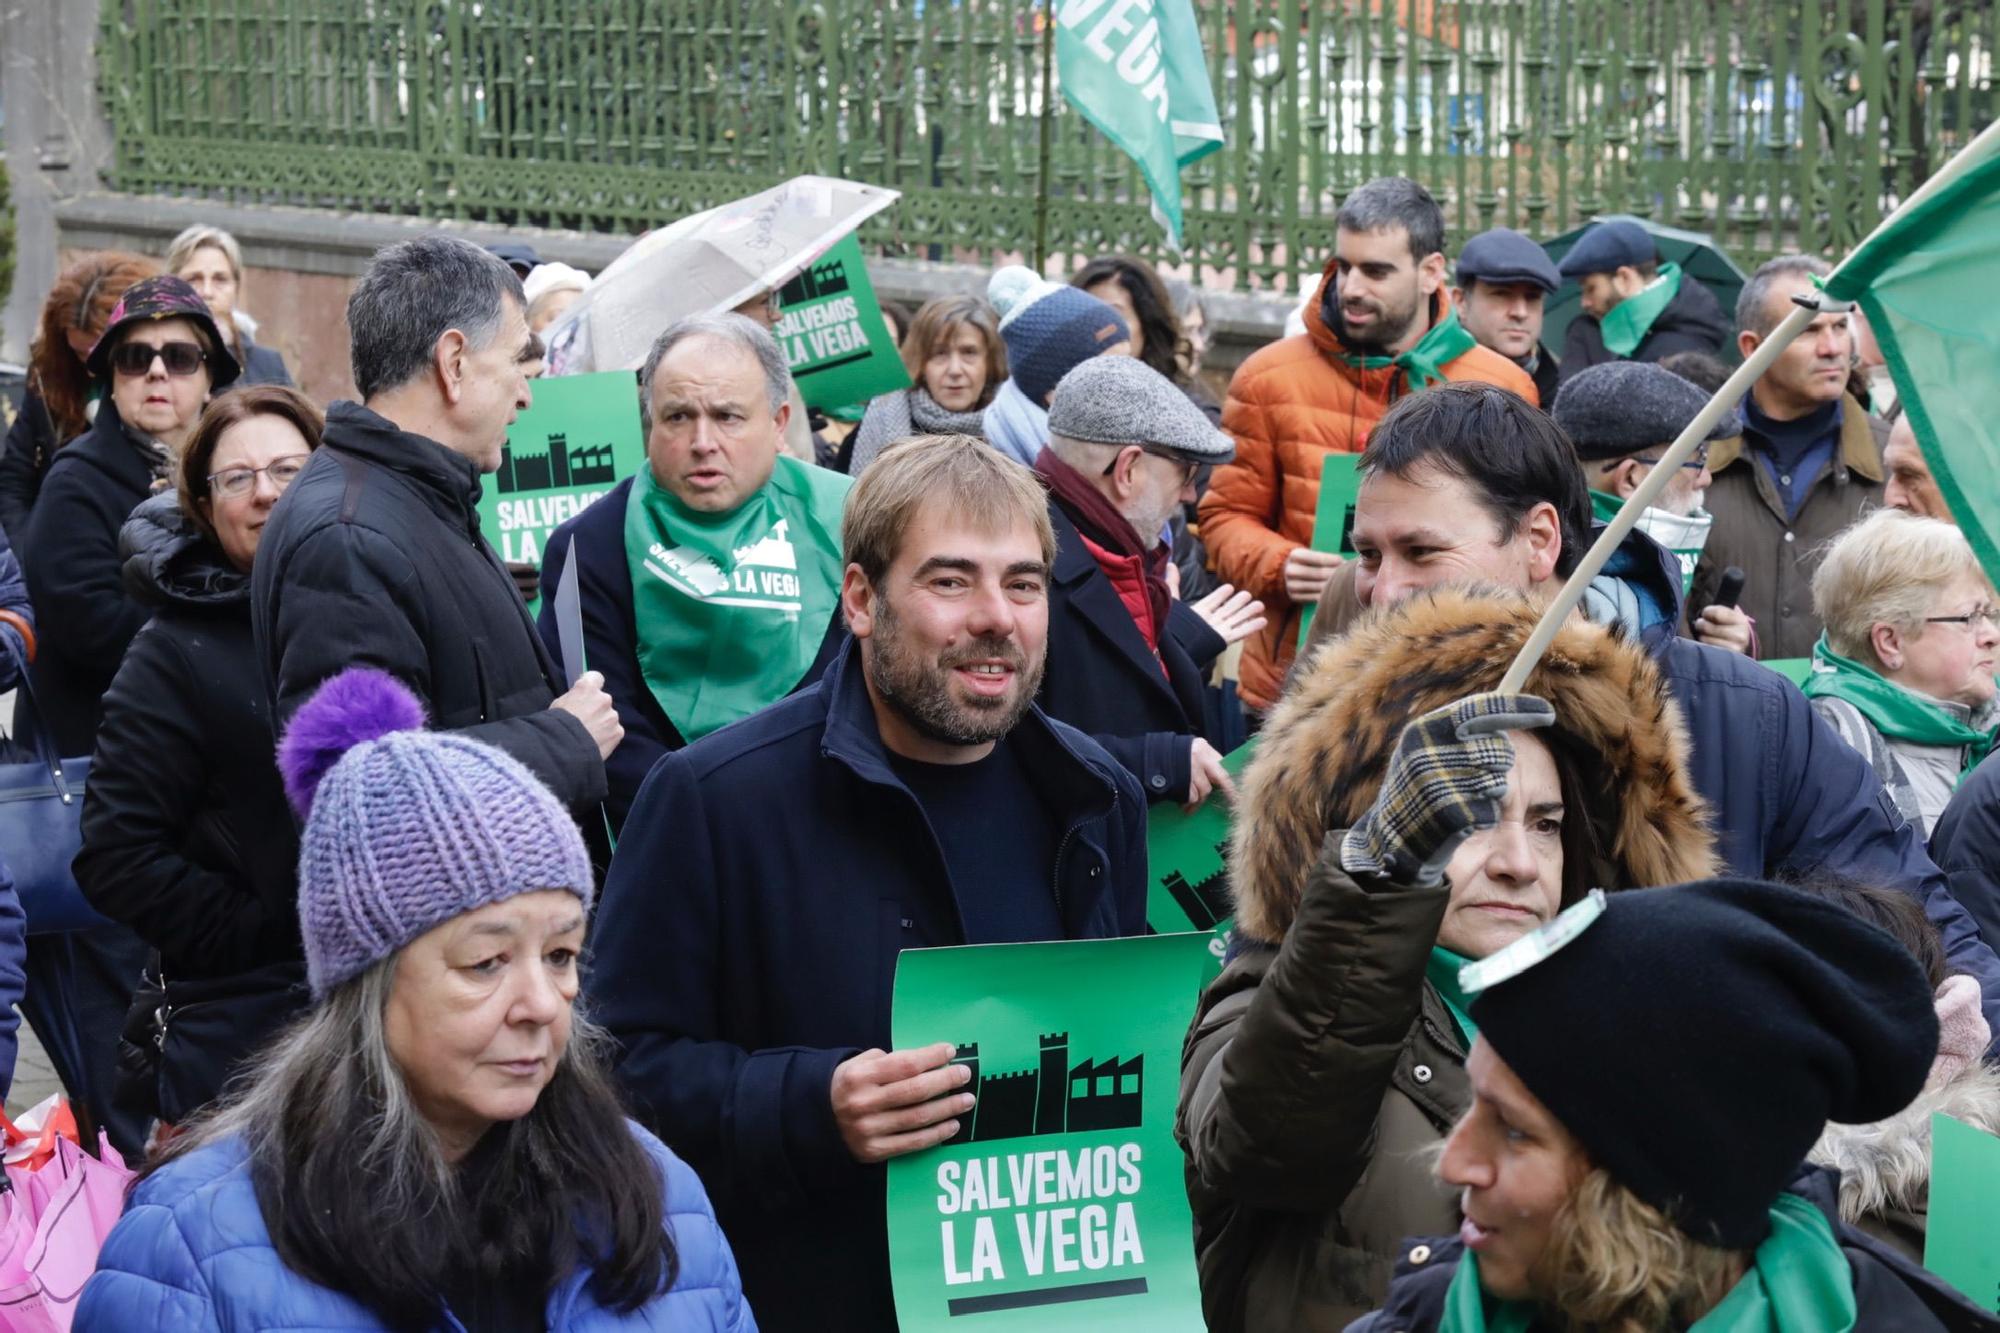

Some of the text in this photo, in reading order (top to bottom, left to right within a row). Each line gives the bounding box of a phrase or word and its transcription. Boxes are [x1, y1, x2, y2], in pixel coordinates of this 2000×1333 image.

[775, 296, 859, 338] SALVEMOS
[781, 320, 869, 367] LA VEGA
[497, 489, 611, 531] SALVEM
[502, 530, 540, 564] LA
[733, 570, 757, 593] LA
[937, 1142, 1142, 1214] SALVEMOS
[941, 1201, 1145, 1285] LA VEGA
